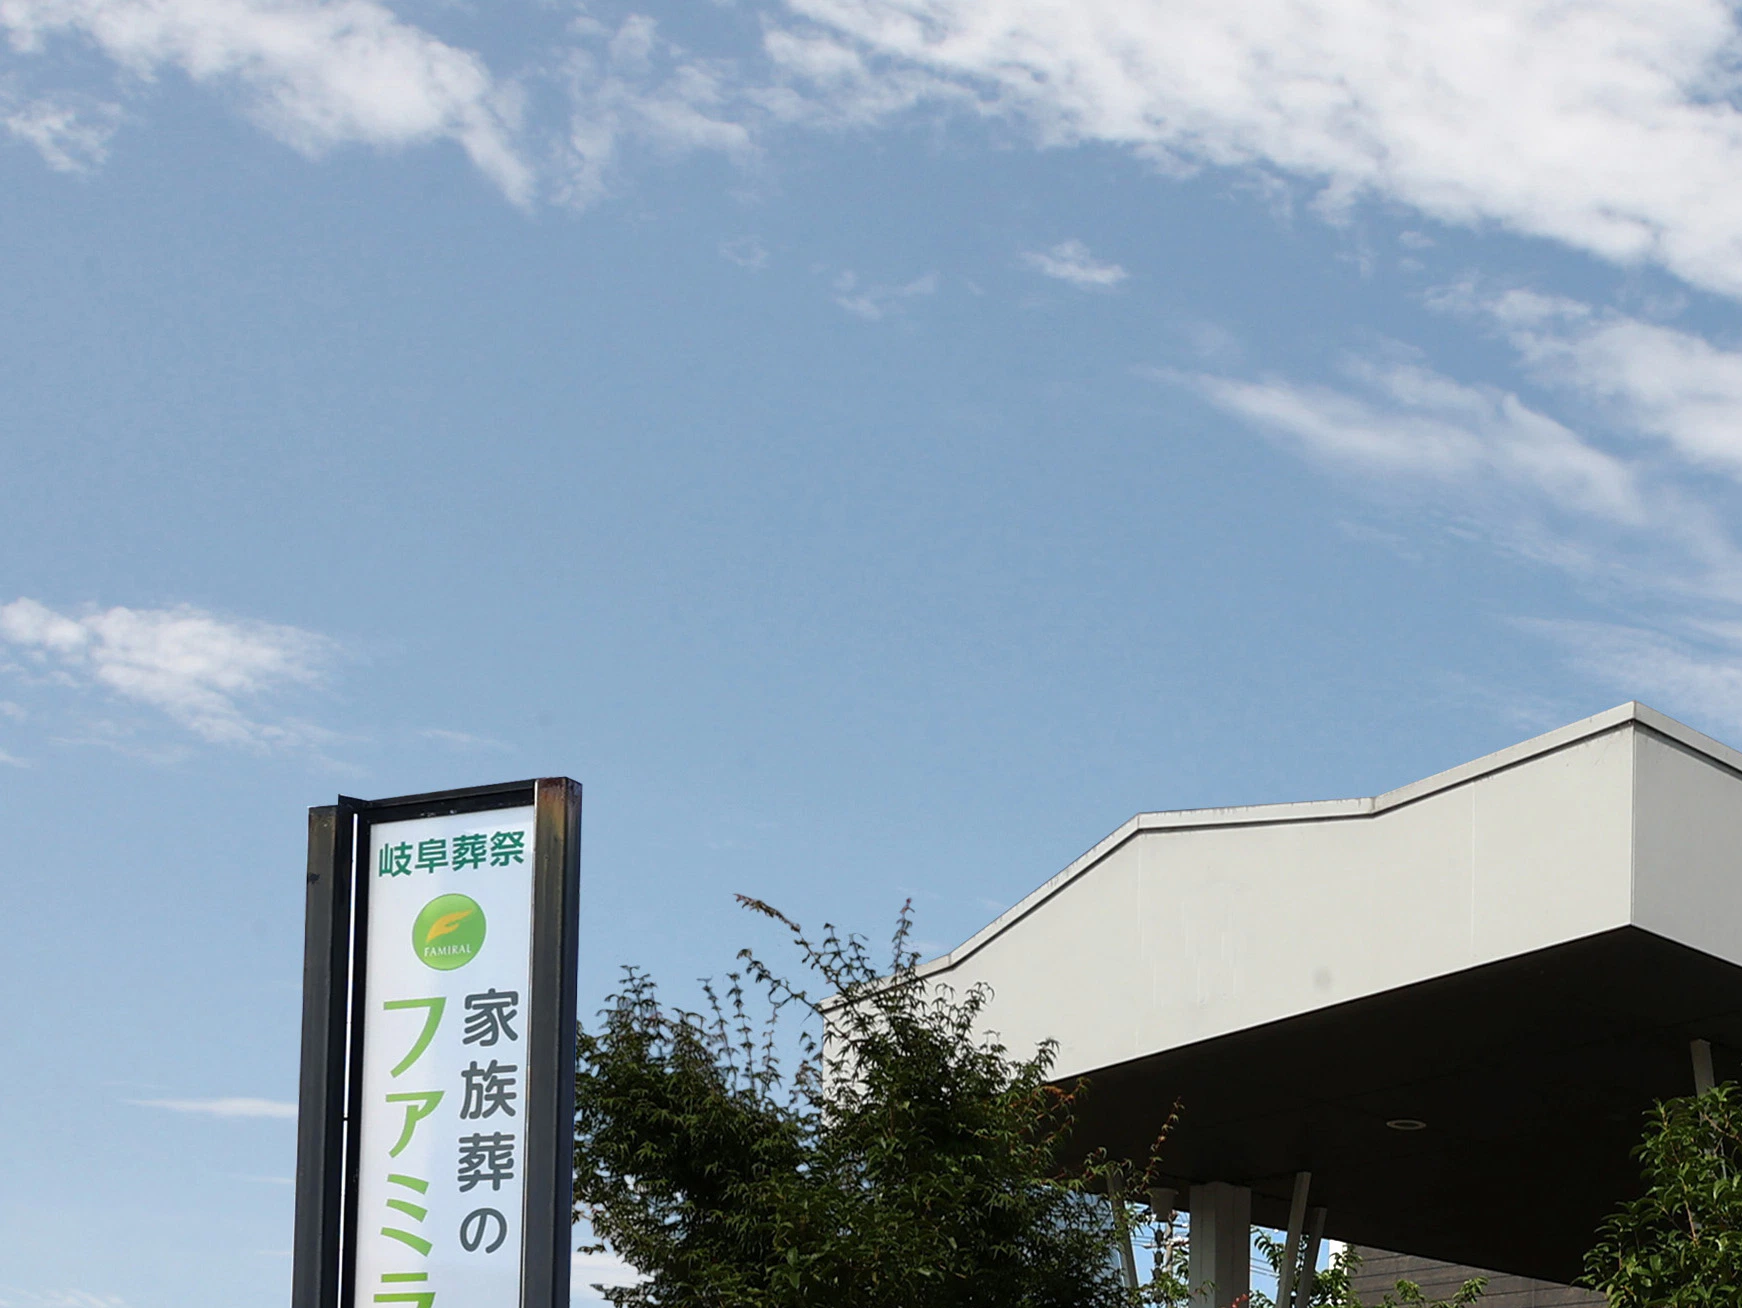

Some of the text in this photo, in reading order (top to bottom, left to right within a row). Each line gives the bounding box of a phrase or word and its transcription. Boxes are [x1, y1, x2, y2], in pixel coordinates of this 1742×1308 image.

[378, 831, 525, 877] 岐阜葬祭
[424, 944, 471, 957] FAMIRAL
[457, 988, 519, 1254] 家族葬の
